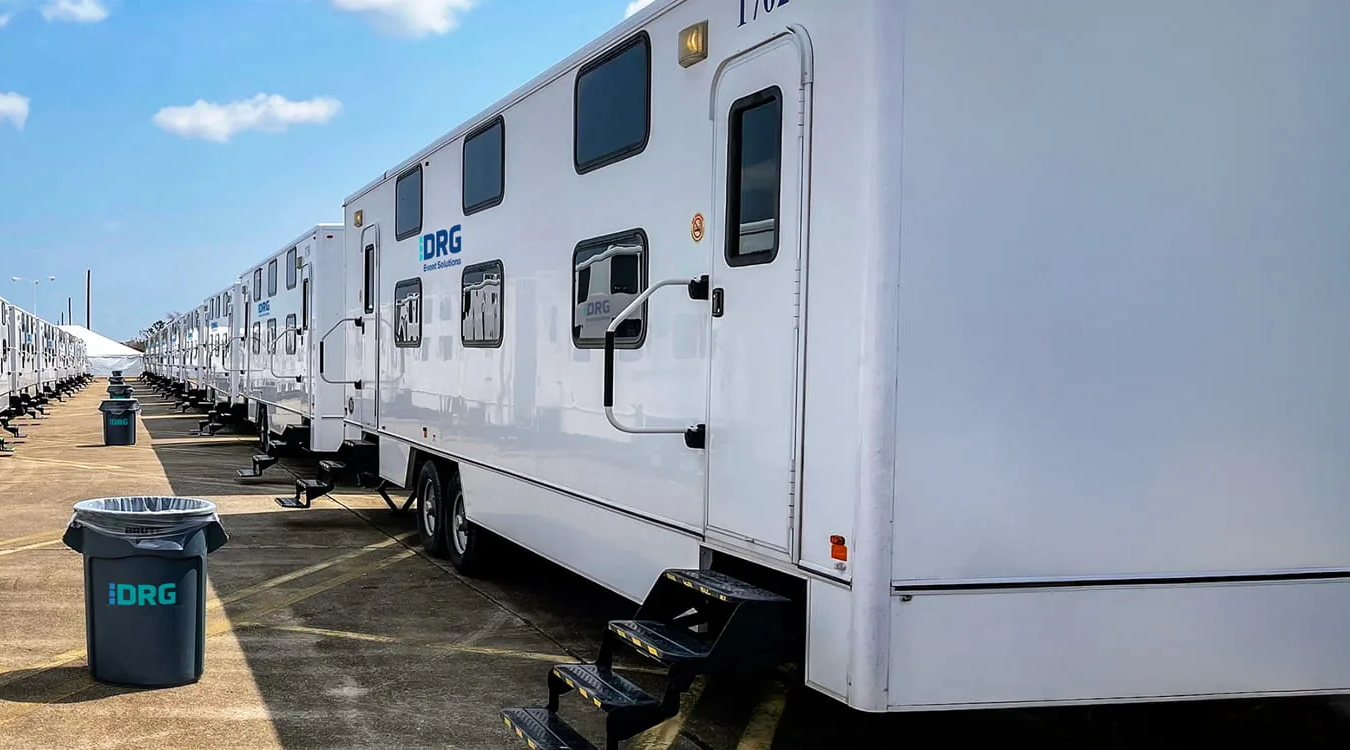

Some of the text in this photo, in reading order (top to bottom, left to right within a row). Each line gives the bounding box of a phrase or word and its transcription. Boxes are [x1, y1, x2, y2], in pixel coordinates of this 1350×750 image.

[737, 0, 789, 28] 17
[423, 224, 461, 260] DRG
[423, 258, 462, 272] Event Solutions
[116, 583, 177, 606] DRG
